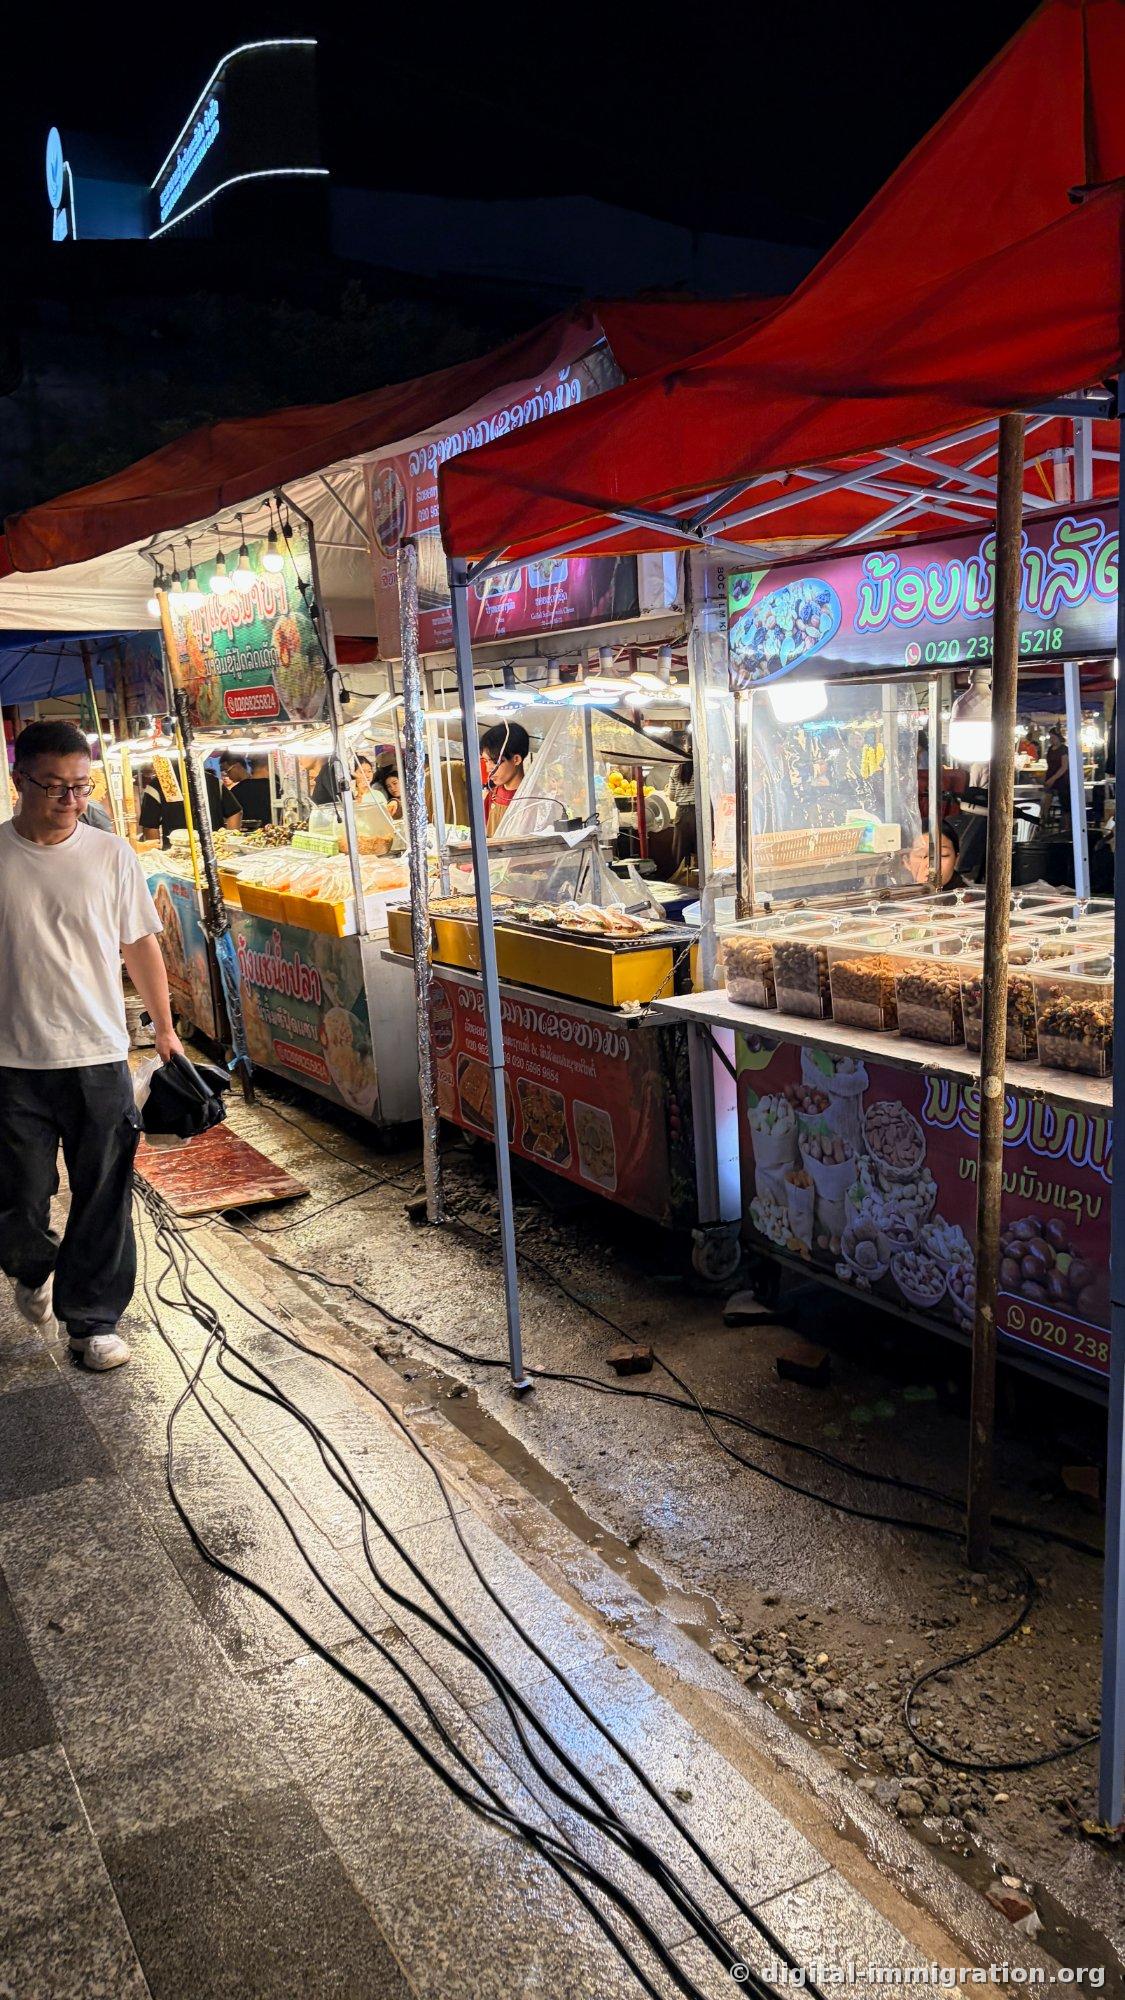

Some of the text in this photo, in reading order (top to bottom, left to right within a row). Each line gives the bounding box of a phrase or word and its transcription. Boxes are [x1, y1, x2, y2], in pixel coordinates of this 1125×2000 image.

[856, 517, 1118, 633] ນ້ອຍເາລັດ
[925, 627, 1063, 664] 020 23 5218
[1030, 1317, 1067, 1346] 020
